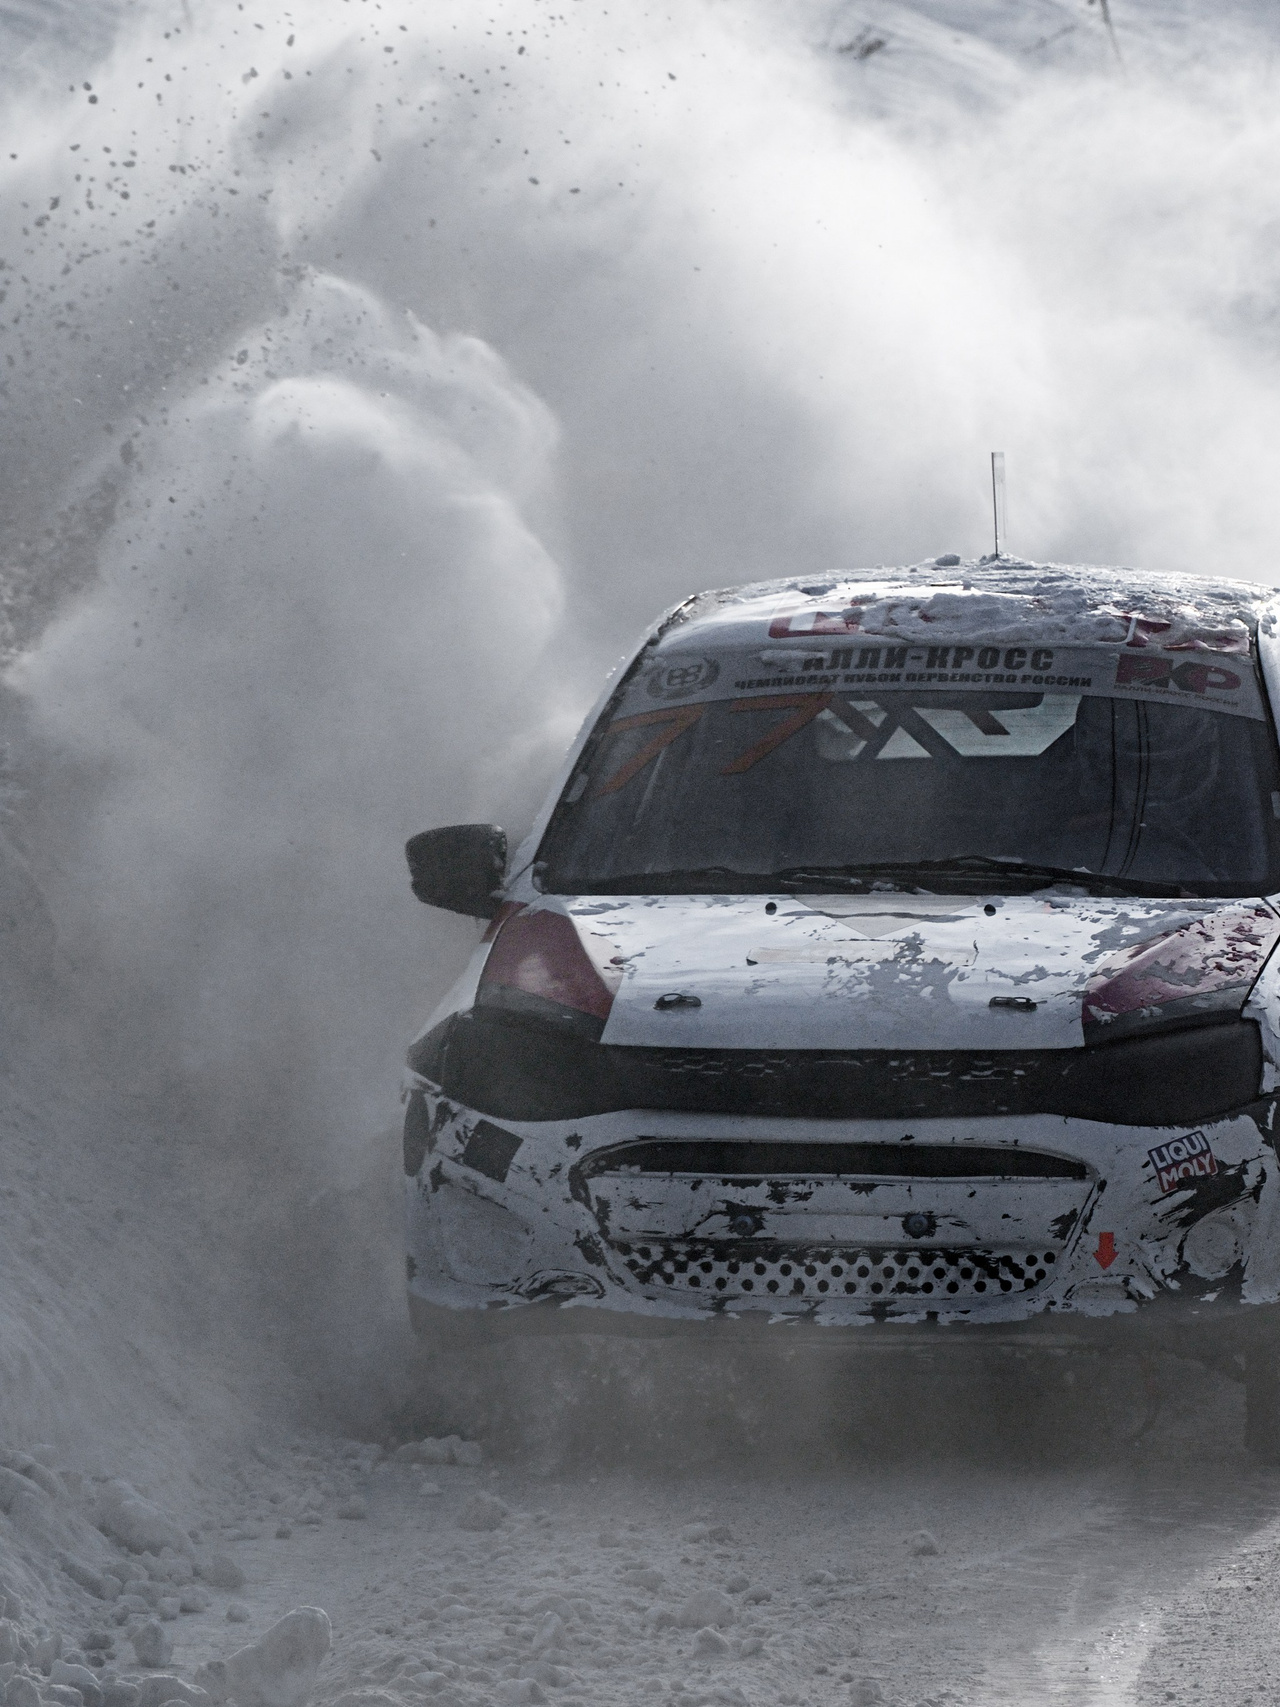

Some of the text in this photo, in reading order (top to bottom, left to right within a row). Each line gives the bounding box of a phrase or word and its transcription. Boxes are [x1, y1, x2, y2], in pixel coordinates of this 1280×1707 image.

[778, 646, 1054, 672] АЛЛИ-КРОСС
[844, 673, 901, 683] КУБОК
[906, 673, 1017, 683] ПЕРВЕНСТВО
[1021, 674, 1092, 688] РОССИИ
[1151, 1133, 1208, 1168] LIQUI
[1160, 1153, 1212, 1191] MOLY
